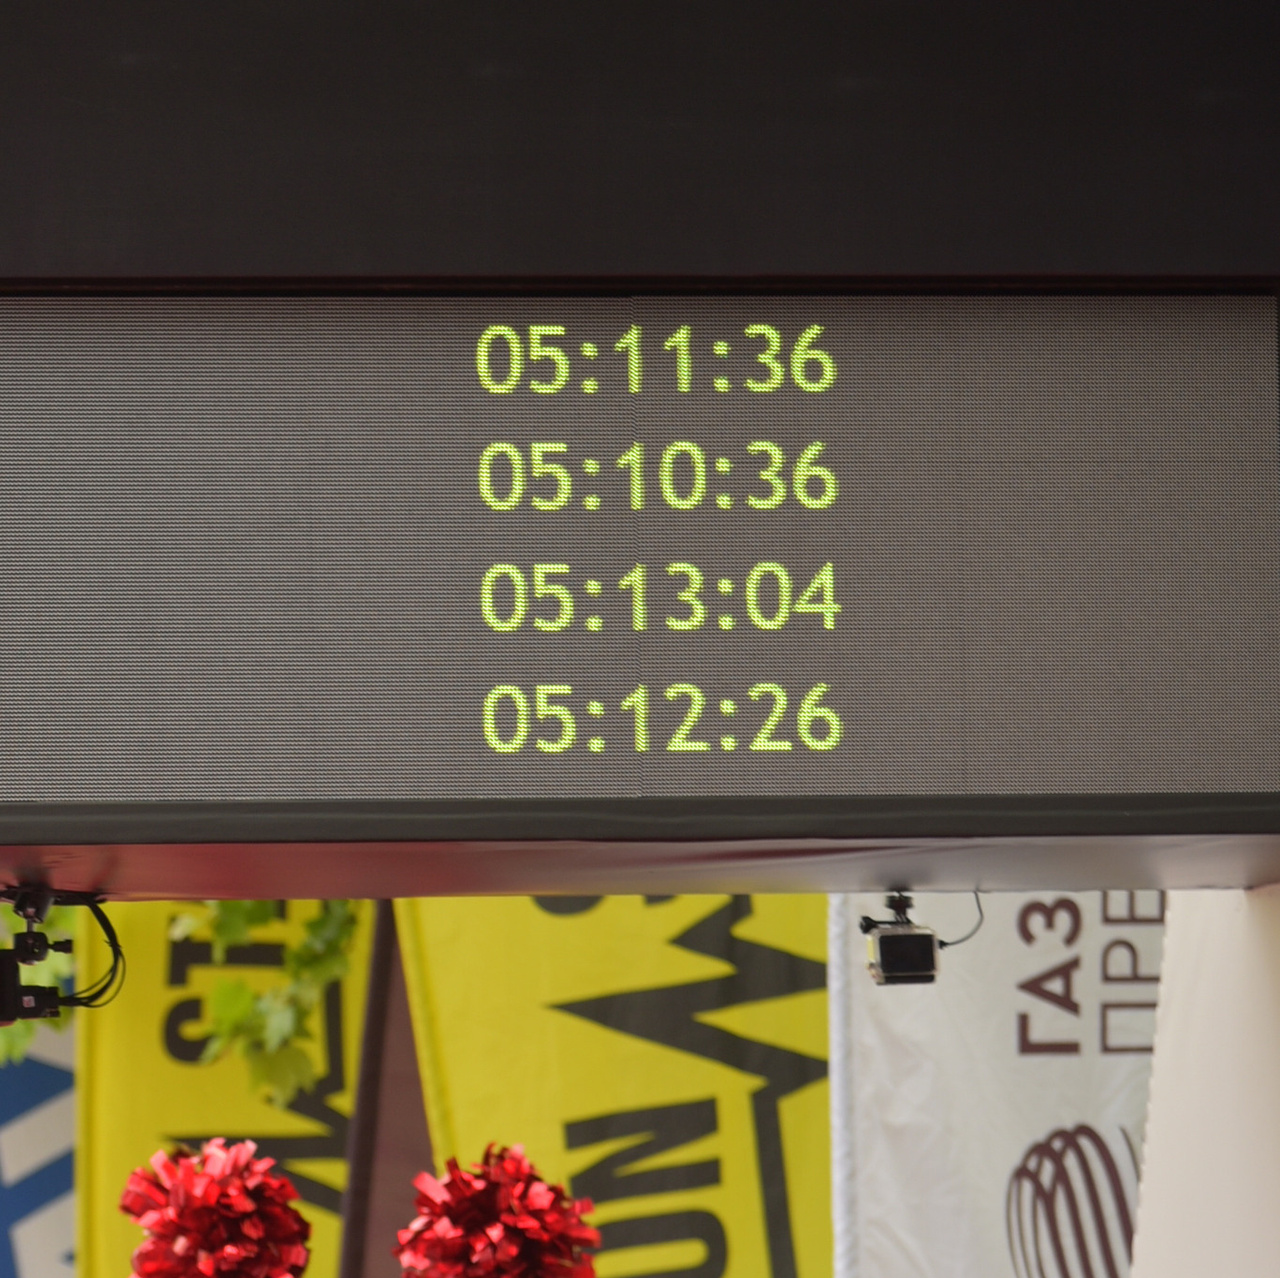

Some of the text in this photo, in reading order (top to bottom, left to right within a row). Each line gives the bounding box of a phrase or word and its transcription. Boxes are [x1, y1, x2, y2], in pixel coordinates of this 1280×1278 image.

[476, 324, 837, 394] 05:11:36
[478, 440, 838, 510] 05:10:36
[480, 561, 841, 631] 05:13:04
[483, 682, 843, 755] 05:12:26
